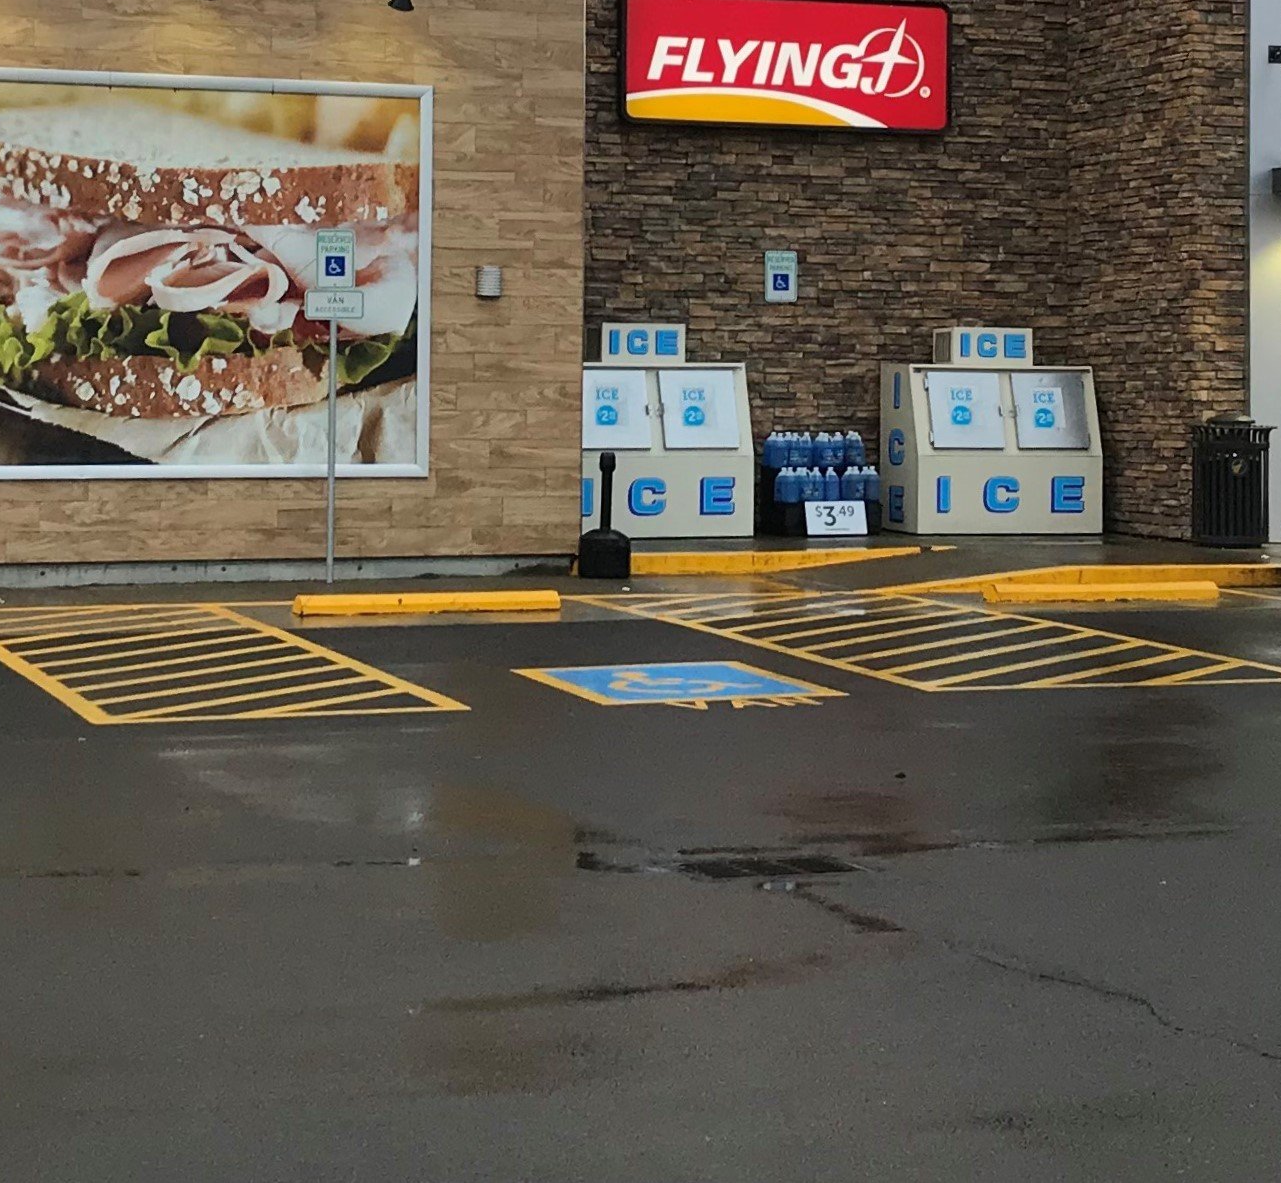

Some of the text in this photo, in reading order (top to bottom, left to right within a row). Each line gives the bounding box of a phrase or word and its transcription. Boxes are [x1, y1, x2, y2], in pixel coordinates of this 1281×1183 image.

[646, 36, 863, 89] FLYING
[320, 245, 350, 253] PARKING
[608, 329, 679, 356] ICE
[960, 332, 1027, 358] ICE
[595, 387, 619, 401] ICE
[682, 388, 705, 402] ICE
[950, 387, 973, 401] ICE
[1033, 392, 1055, 404] ICE
[582, 477, 736, 517] ICE
[936, 475, 1085, 514] ICE
[815, 505, 855, 527] $3.49
